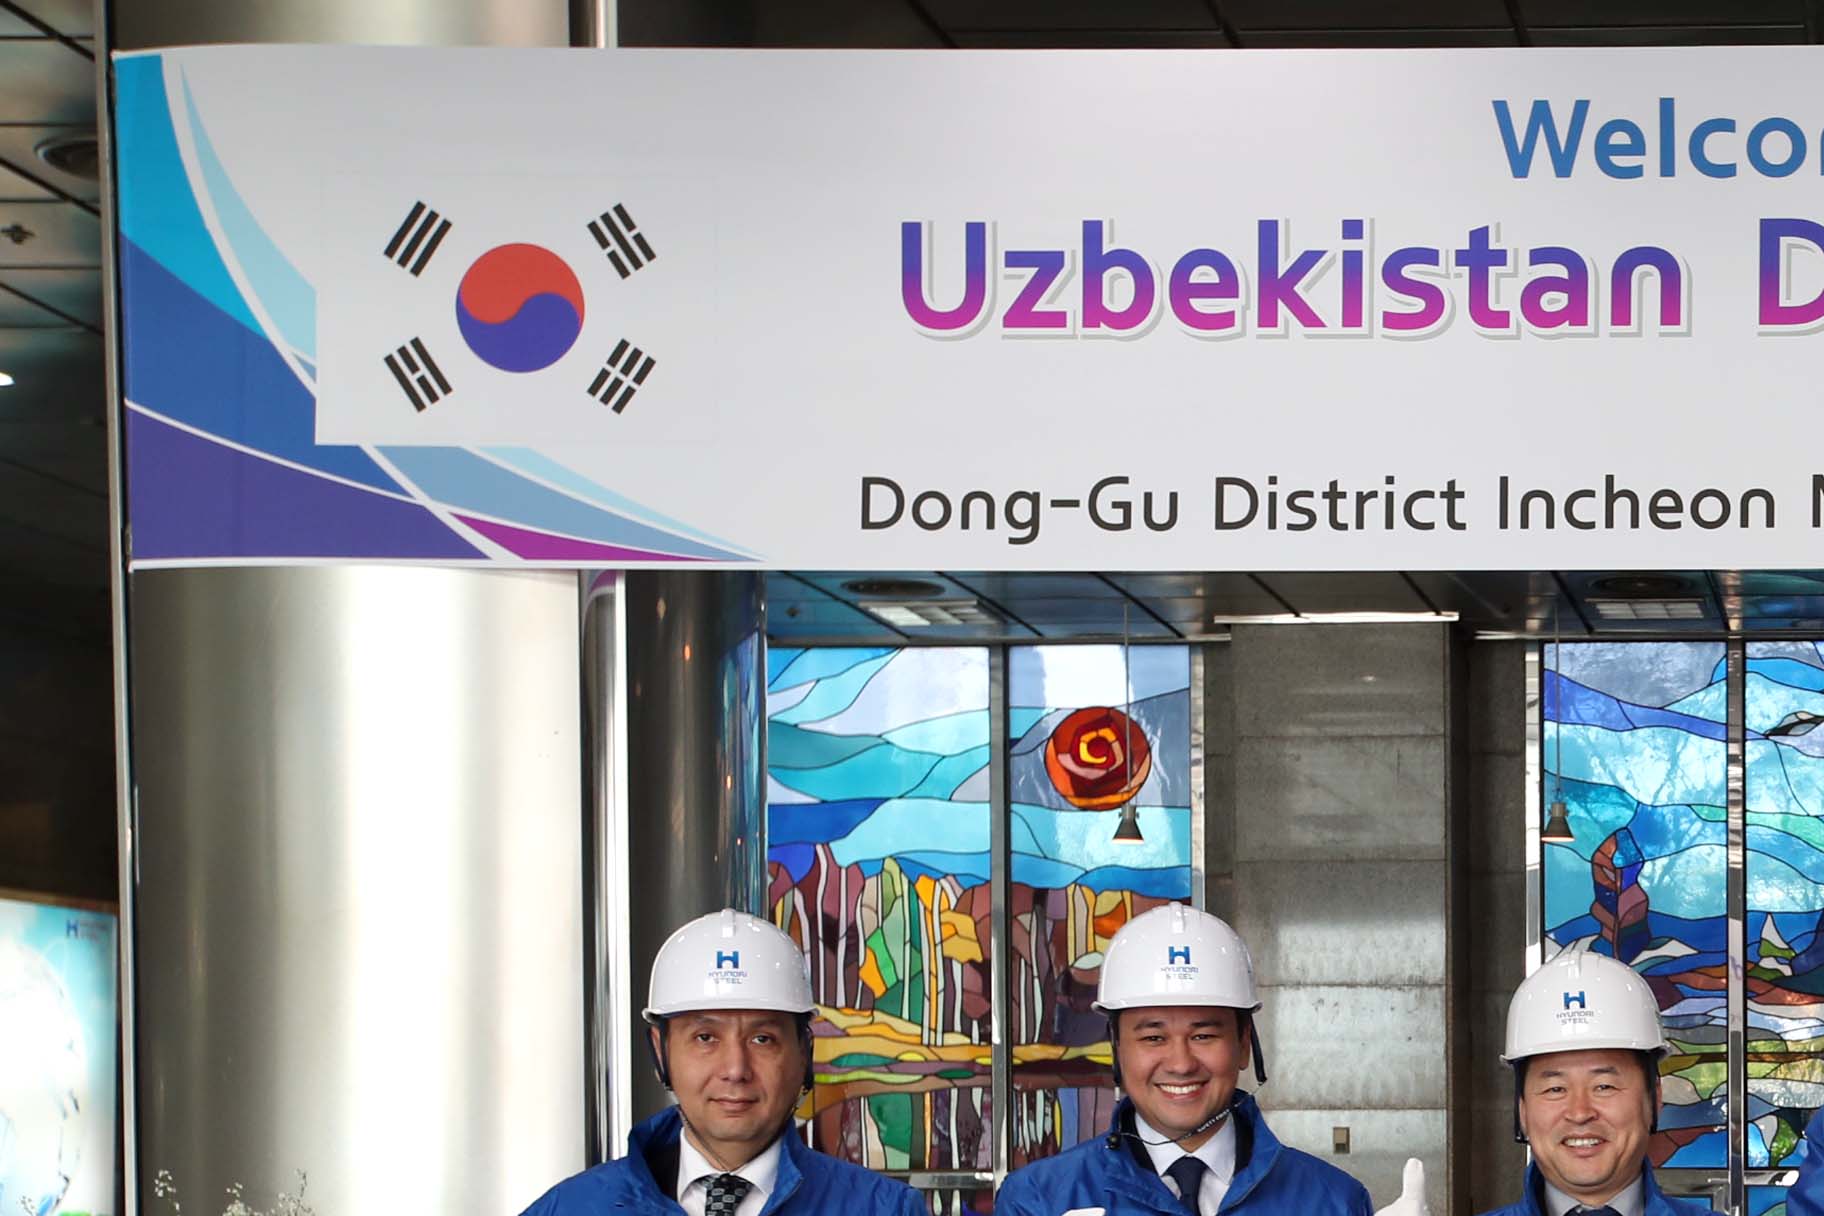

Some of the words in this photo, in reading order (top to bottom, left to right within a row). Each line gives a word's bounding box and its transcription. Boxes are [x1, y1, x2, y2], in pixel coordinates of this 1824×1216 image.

[903, 220, 1680, 330] Uzbekistan
[862, 476, 1177, 544] Dong-Gu
[1215, 476, 1466, 531] District
[1500, 475, 1774, 529] Incheon
[716, 951, 739, 969] H
[1169, 946, 1190, 965] H
[1563, 991, 1586, 1010] H
